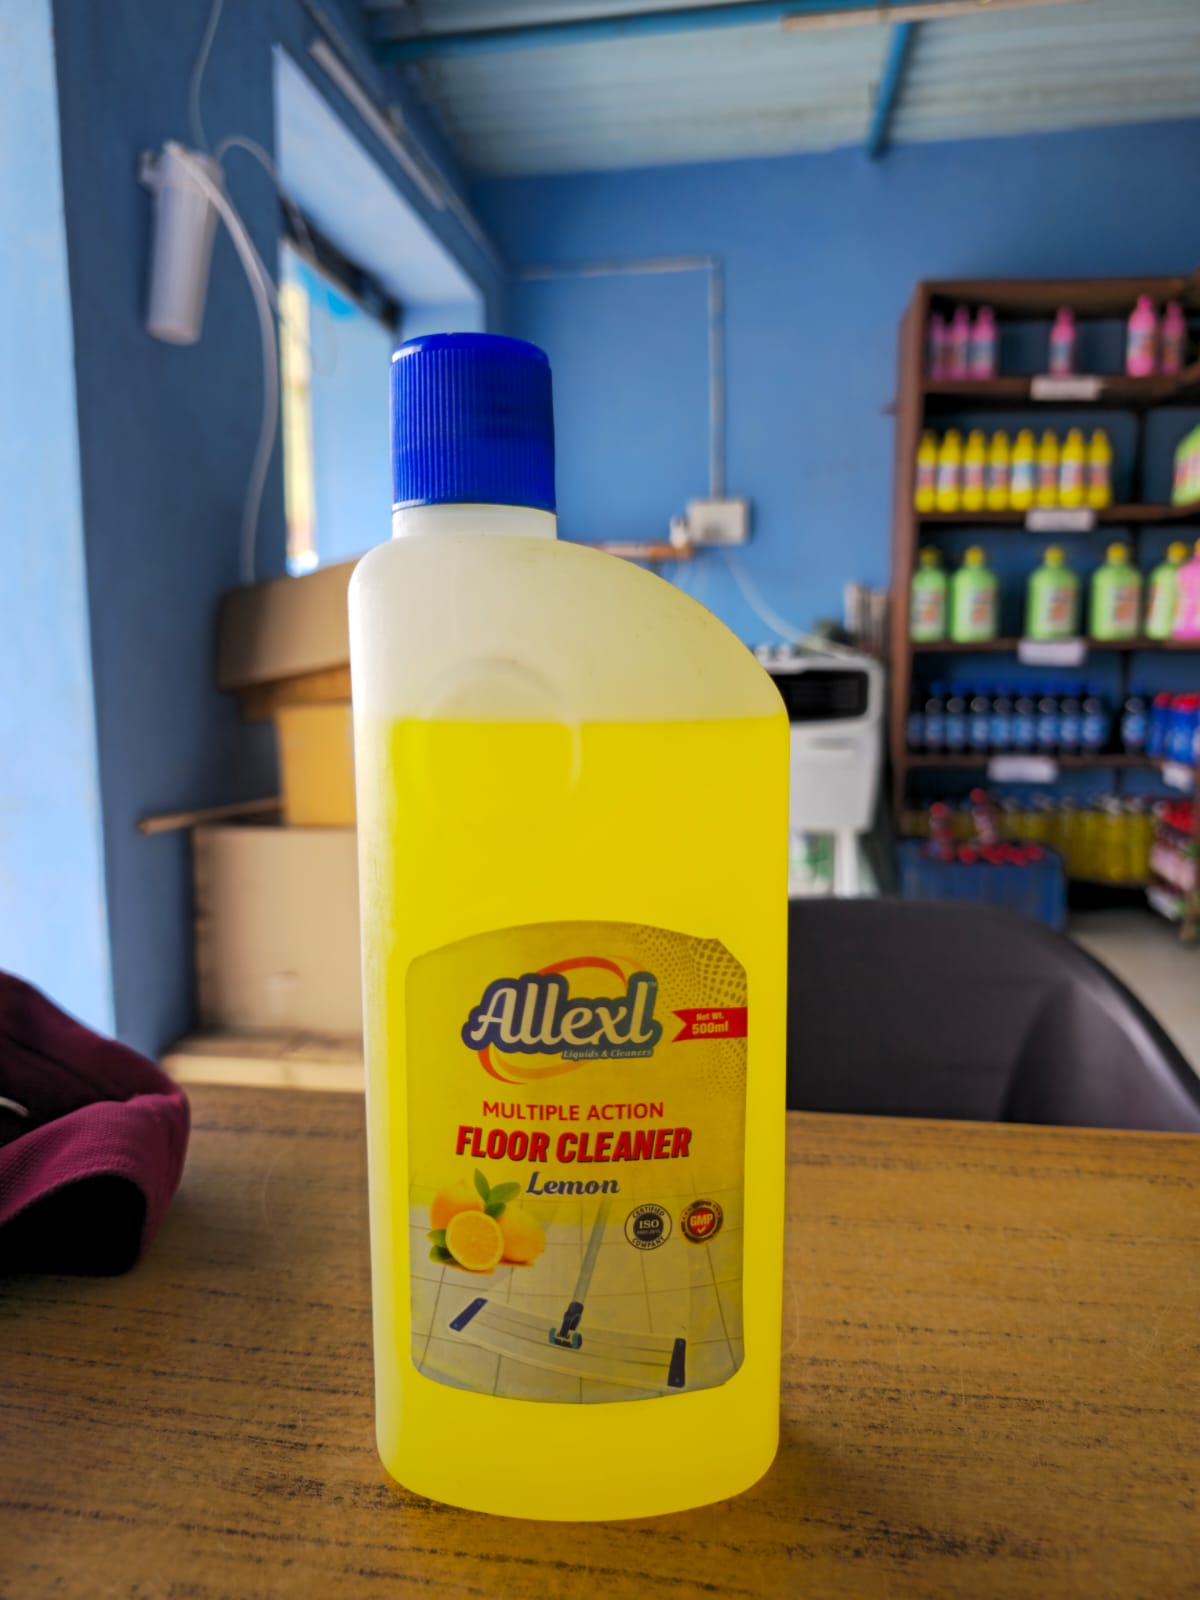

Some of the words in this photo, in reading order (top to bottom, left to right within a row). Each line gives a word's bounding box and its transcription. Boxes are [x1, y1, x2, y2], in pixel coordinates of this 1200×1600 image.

[470, 981, 654, 1046] Allexl
[692, 1021, 728, 1035] 500ml
[562, 1049, 599, 1060] Liquids
[600, 1049, 608, 1058] &
[610, 1048, 652, 1058] Cleaners
[482, 1101, 580, 1121] MULTIPLE
[587, 1102, 664, 1121] ACTION
[456, 1125, 550, 1163] FLOOR
[556, 1127, 692, 1163] CLEANER
[526, 1171, 620, 1195] Lemon
[639, 1219, 660, 1229] ISO
[690, 1213, 713, 1227] GMP
